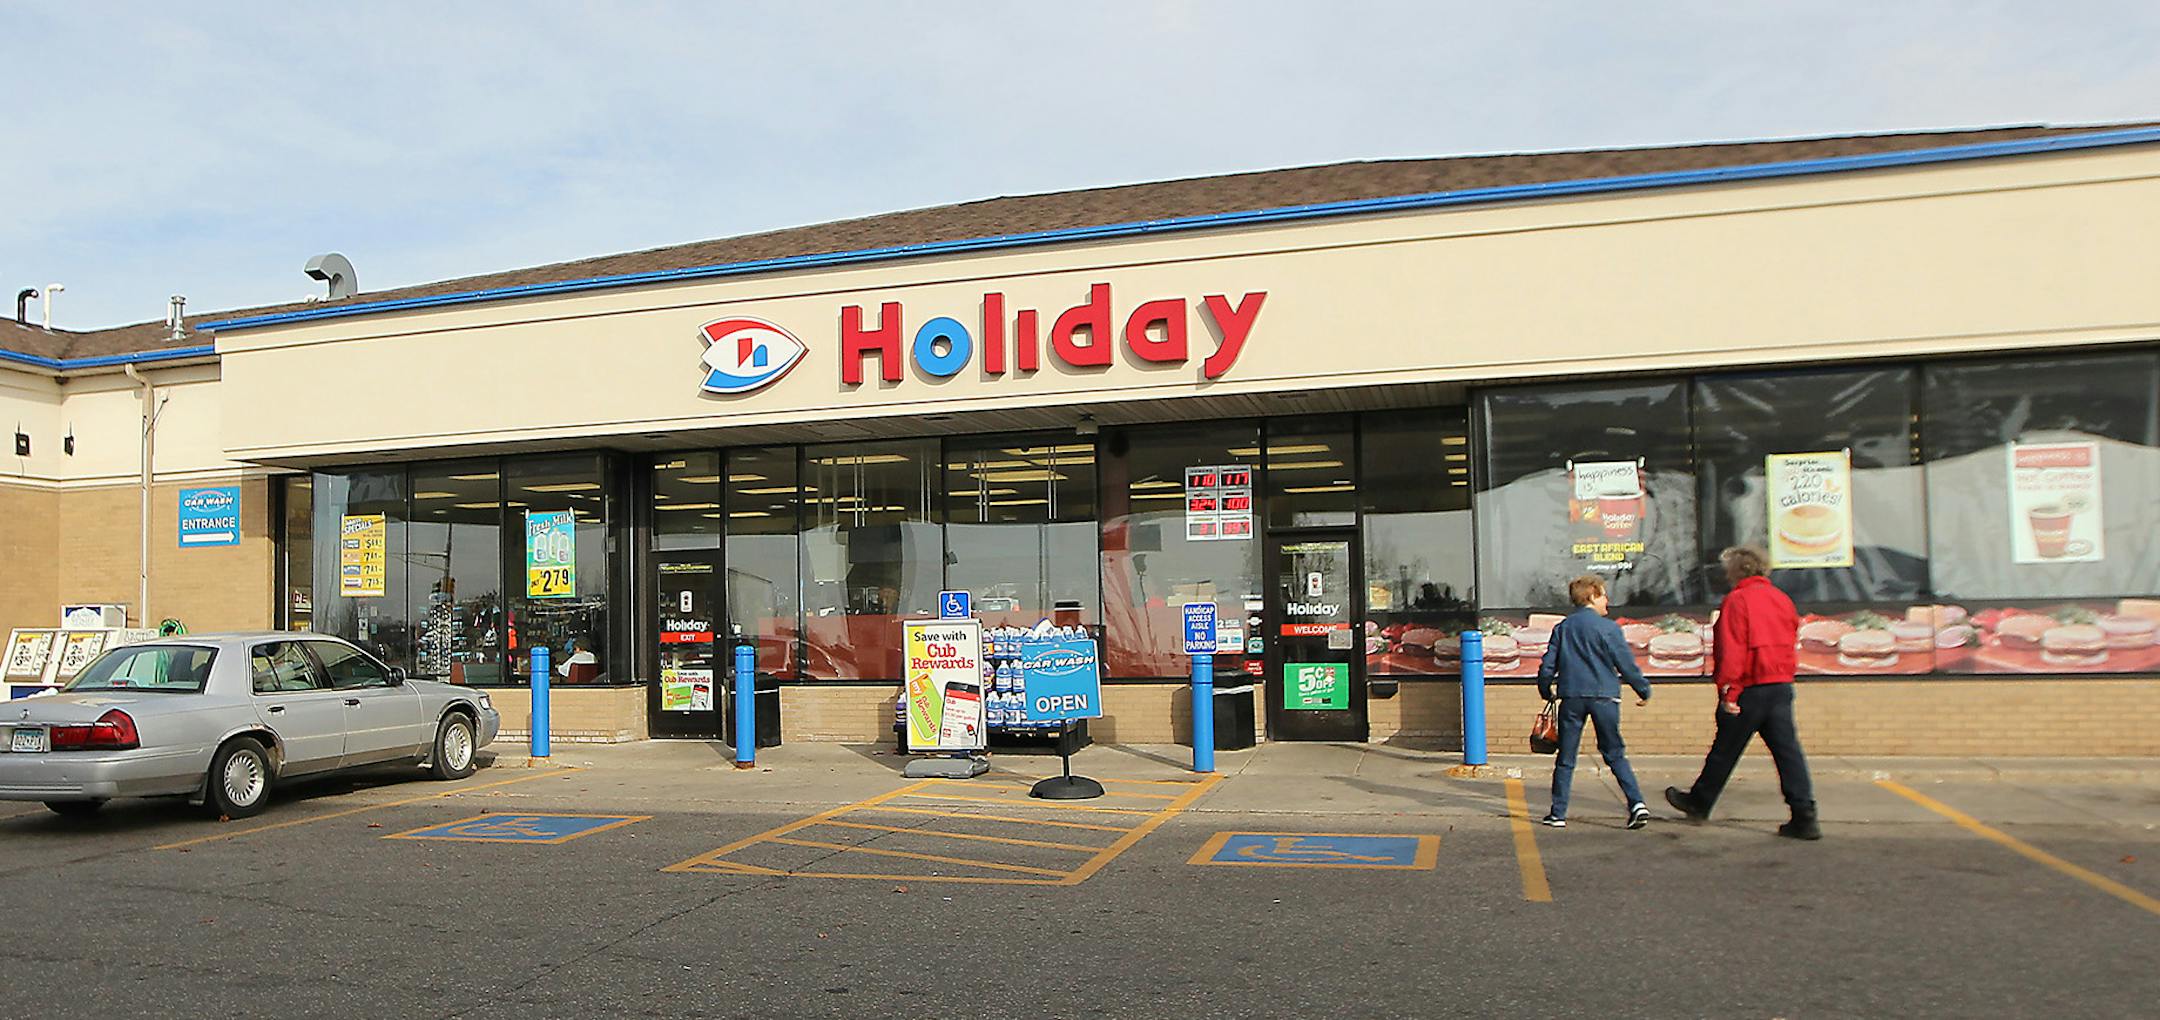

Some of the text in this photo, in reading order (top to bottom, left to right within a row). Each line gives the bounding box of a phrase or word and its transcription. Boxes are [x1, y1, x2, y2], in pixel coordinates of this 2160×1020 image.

[839, 282, 1268, 385] Holiday
[184, 499, 203, 507] CAR
[182, 516, 236, 530] ENTRANCE
[1185, 607, 1214, 615] HANDICAP
[1287, 602, 1340, 617] Holiday
[1188, 614, 1212, 622] ACCESS
[666, 619, 708, 632] Holiday
[1191, 622, 1209, 630] AISLE
[1294, 625, 1337, 635] WELCOME
[914, 630, 967, 642] Save with
[1195, 631, 1206, 640] NO
[927, 643, 957, 658] Cub
[1186, 641, 1215, 650] PARKING
[911, 657, 975, 670] Rewards
[1023, 655, 1095, 670] CAR WASH
[1035, 694, 1088, 713] OPEN
